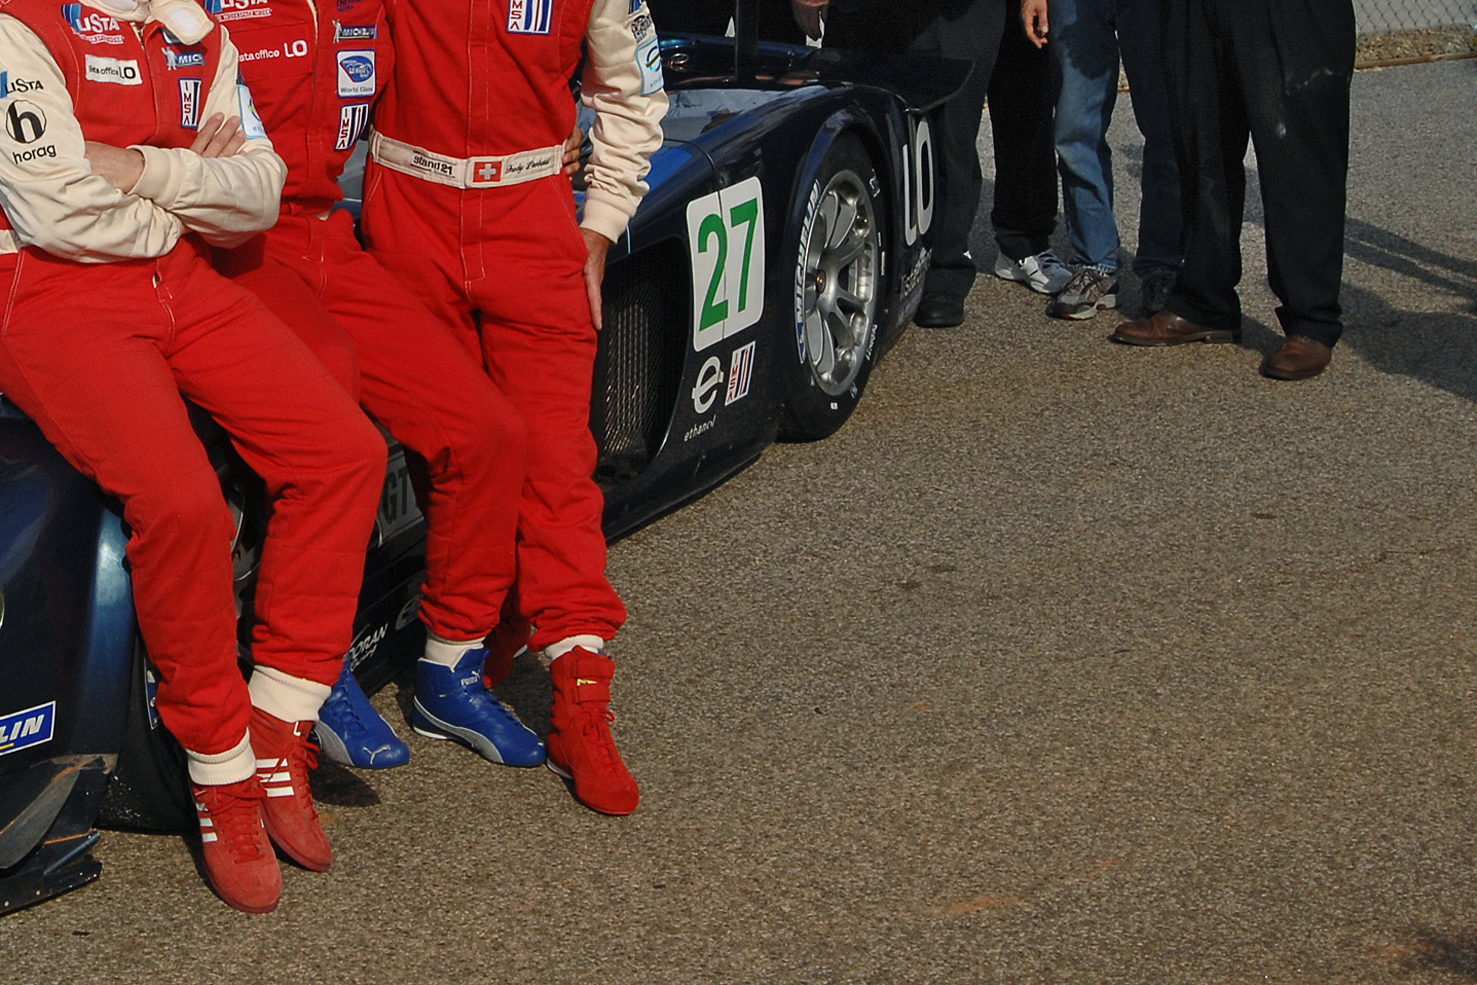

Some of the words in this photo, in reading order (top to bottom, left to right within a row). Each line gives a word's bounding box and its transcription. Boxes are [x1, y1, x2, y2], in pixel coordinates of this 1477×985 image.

[76, 13, 121, 33] LISTA
[255, 49, 280, 60] office
[284, 40, 308, 58] LO
[5, 78, 44, 95] LISTA
[183, 82, 193, 125] IMSA
[338, 108, 350, 149] IMSA
[12, 144, 57, 166] horag
[902, 120, 934, 246] LO
[698, 198, 759, 332] 27
